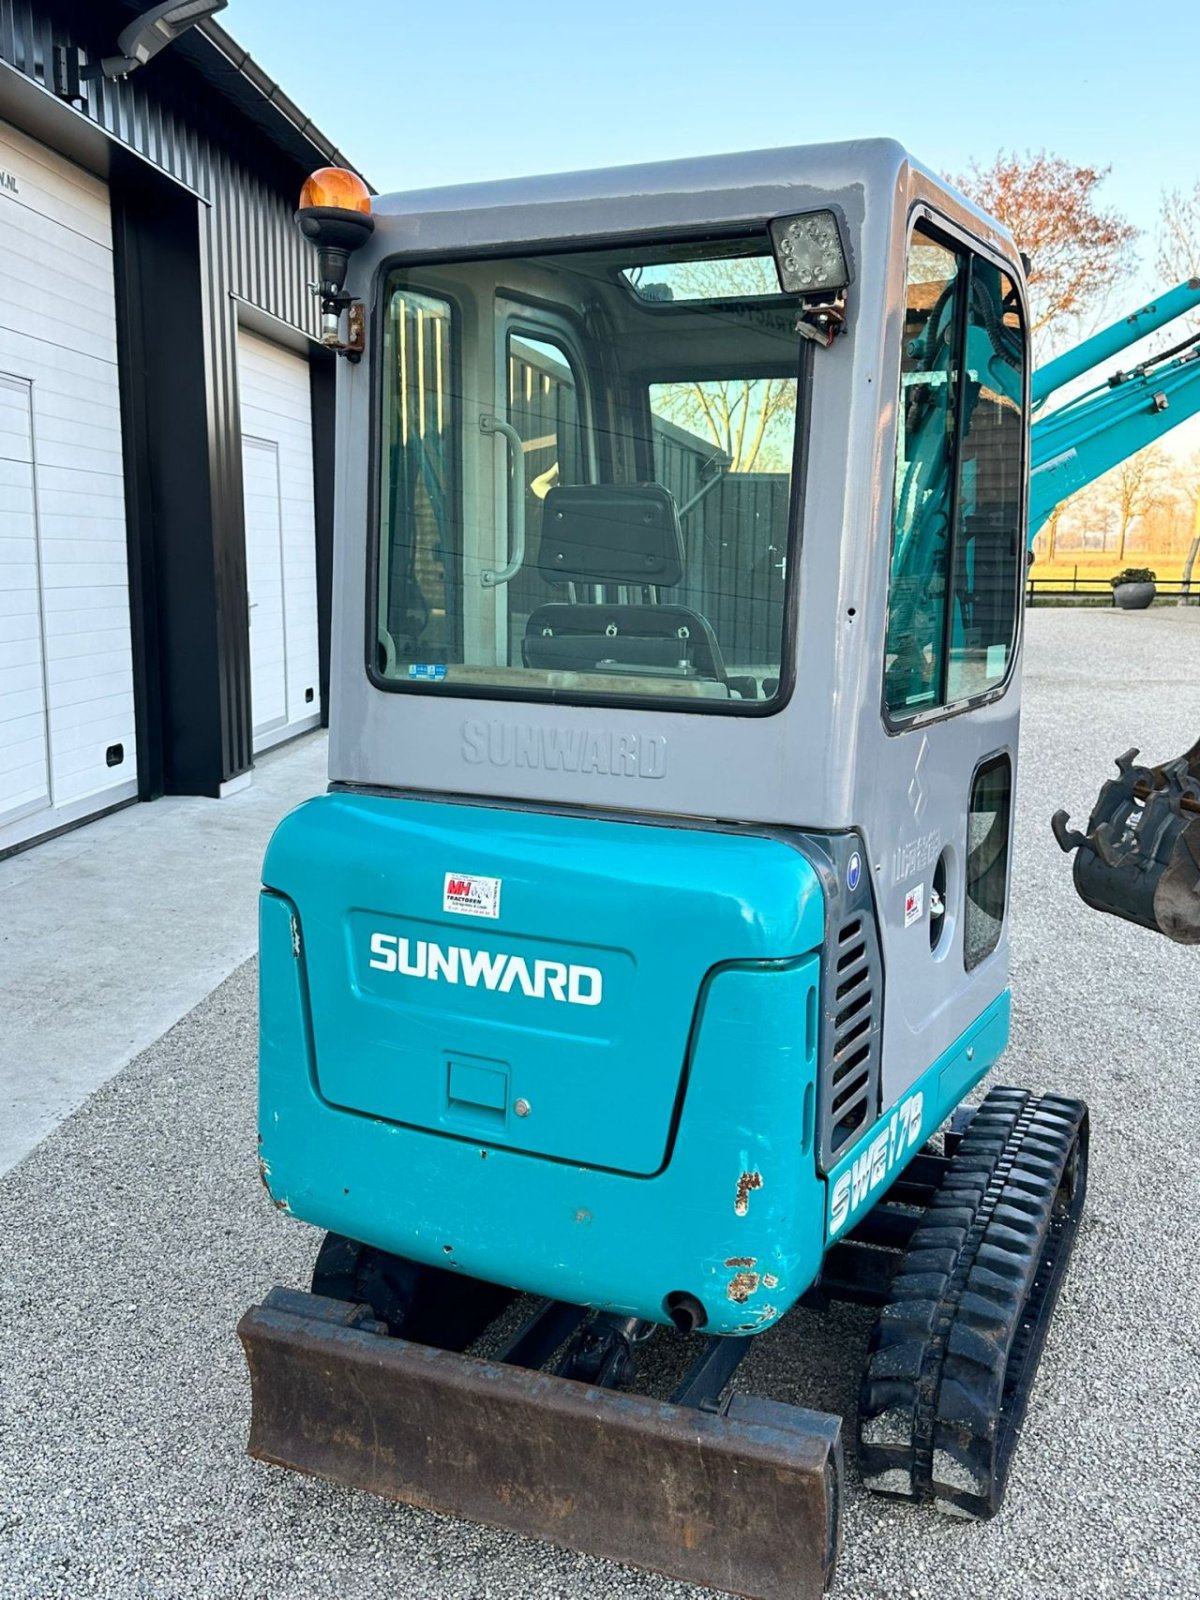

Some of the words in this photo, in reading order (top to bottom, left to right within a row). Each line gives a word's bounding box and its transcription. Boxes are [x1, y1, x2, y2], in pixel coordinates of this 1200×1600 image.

[462, 720, 667, 780] SUNWARD
[447, 879, 472, 896] MH
[369, 932, 603, 1006] SUNWARD
[829, 1091, 924, 1236] SWE17B
